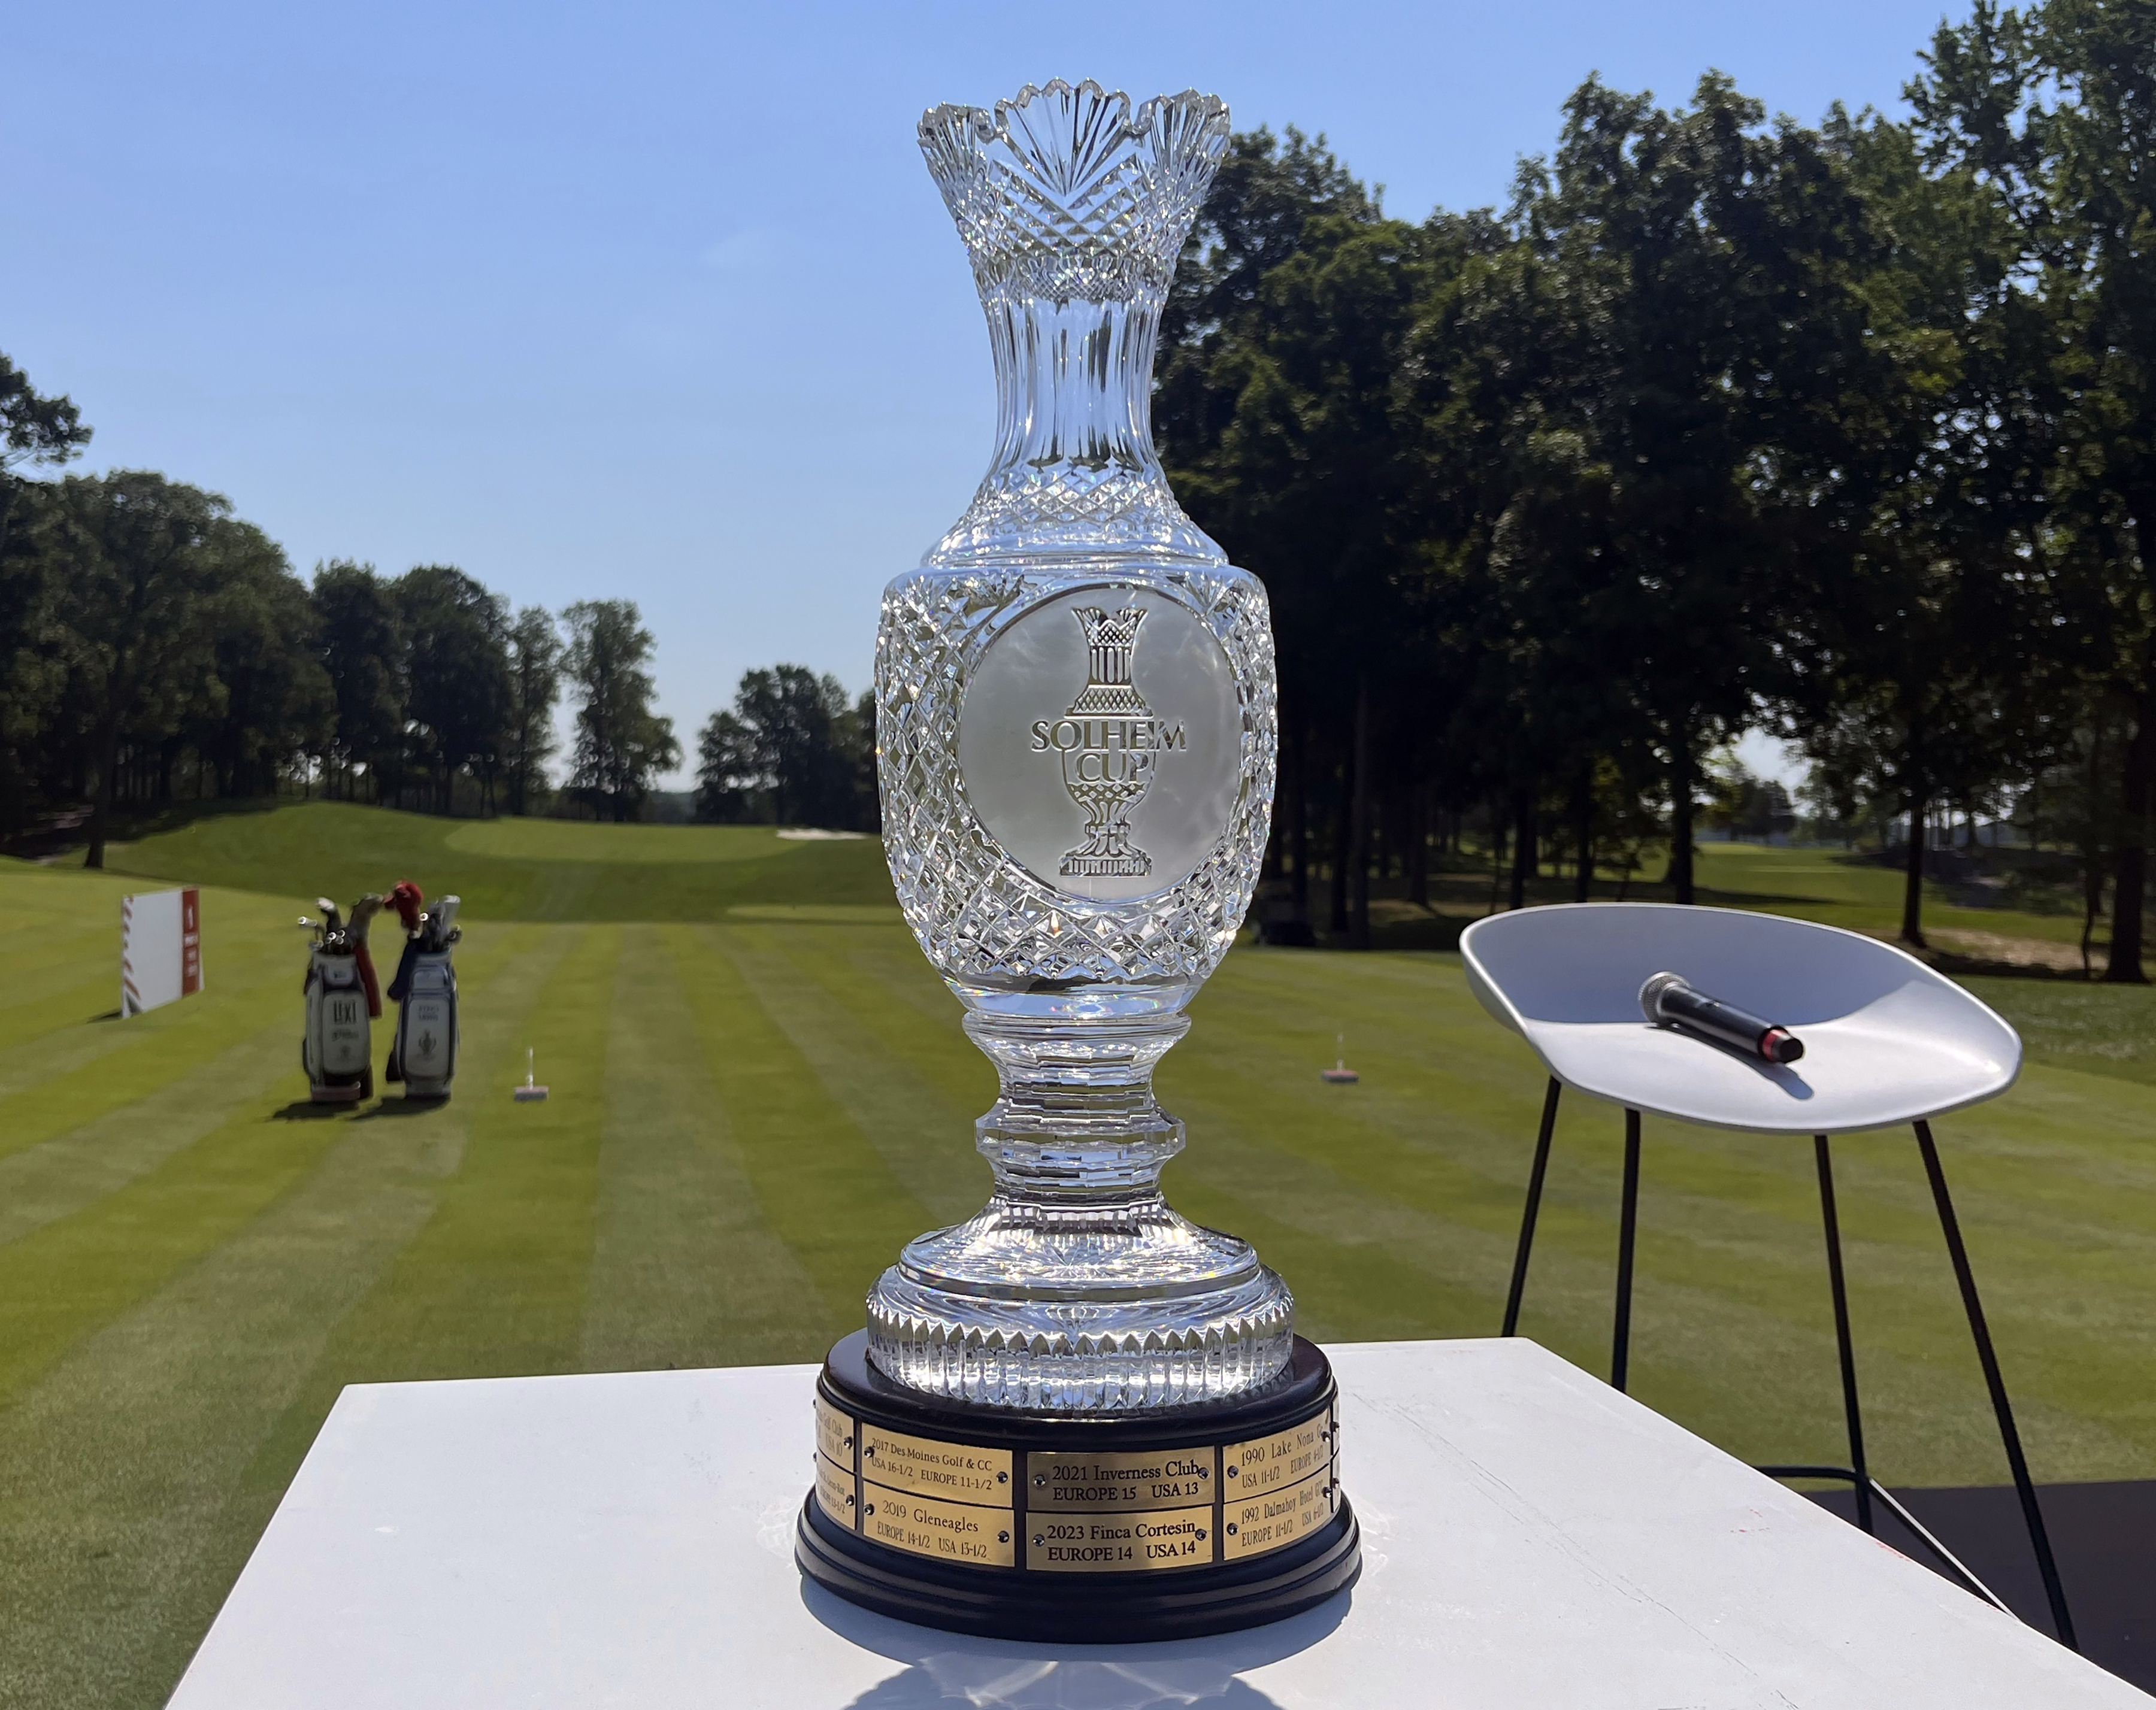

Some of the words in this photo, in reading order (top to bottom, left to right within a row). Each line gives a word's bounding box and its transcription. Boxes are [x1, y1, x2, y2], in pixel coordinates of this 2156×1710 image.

[1031, 720, 1186, 751] SOLHEIM
[1076, 753, 1149, 783] CUP
[871, 1438, 889, 1452] 2017
[891, 1444, 906, 1456] Des
[907, 1447, 940, 1463] Moines
[942, 1451, 964, 1468] Golf
[966, 1458, 975, 1469] &
[977, 1460, 992, 1472] CC
[1241, 1448, 1265, 1466] 1990
[1271, 1442, 1292, 1459] Lake
[1297, 1432, 1314, 1450] Nona
[871, 1456, 886, 1470] USA
[888, 1460, 913, 1477] 16-1/2
[921, 1470, 958, 1486] EUROPE
[961, 1473, 992, 1490] 11-1/2
[1052, 1466, 1088, 1481] 2021
[1094, 1465, 1161, 1481] Inverness
[1165, 1459, 1198, 1477] Club
[1242, 1474, 1257, 1488] USA
[1261, 1466, 1280, 1484] 11-1/2
[1291, 1451, 1312, 1473] EUROPE
[1053, 1487, 1118, 1501] EUROPE
[1122, 1487, 1137, 1500] 15
[1152, 1483, 1182, 1497] USA
[1186, 1482, 1198, 1495] 13
[883, 1500, 907, 1518] 2019
[914, 1509, 979, 1533] Gleneagles
[1241, 1506, 1259, 1524] 1992
[1264, 1498, 1297, 1519] Dalmahoy
[877, 1521, 905, 1542] EUROPE
[908, 1530, 931, 1549] 14-1/2
[939, 1538, 956, 1554] USA
[961, 1542, 988, 1558] 13-1/2
[1047, 1525, 1085, 1539] 2023
[1091, 1525, 1131, 1539] Finca
[1135, 1520, 1196, 1538] Cortesin
[1241, 1526, 1272, 1547] EUROPE
[1276, 1519, 1293, 1538] 11-1/2
[1301, 1510, 1312, 1526] USA
[1047, 1547, 1113, 1561] EUROPE
[1118, 1547, 1132, 1560] 14
[1146, 1544, 1179, 1559] USA
[1182, 1541, 1196, 1556] 14
